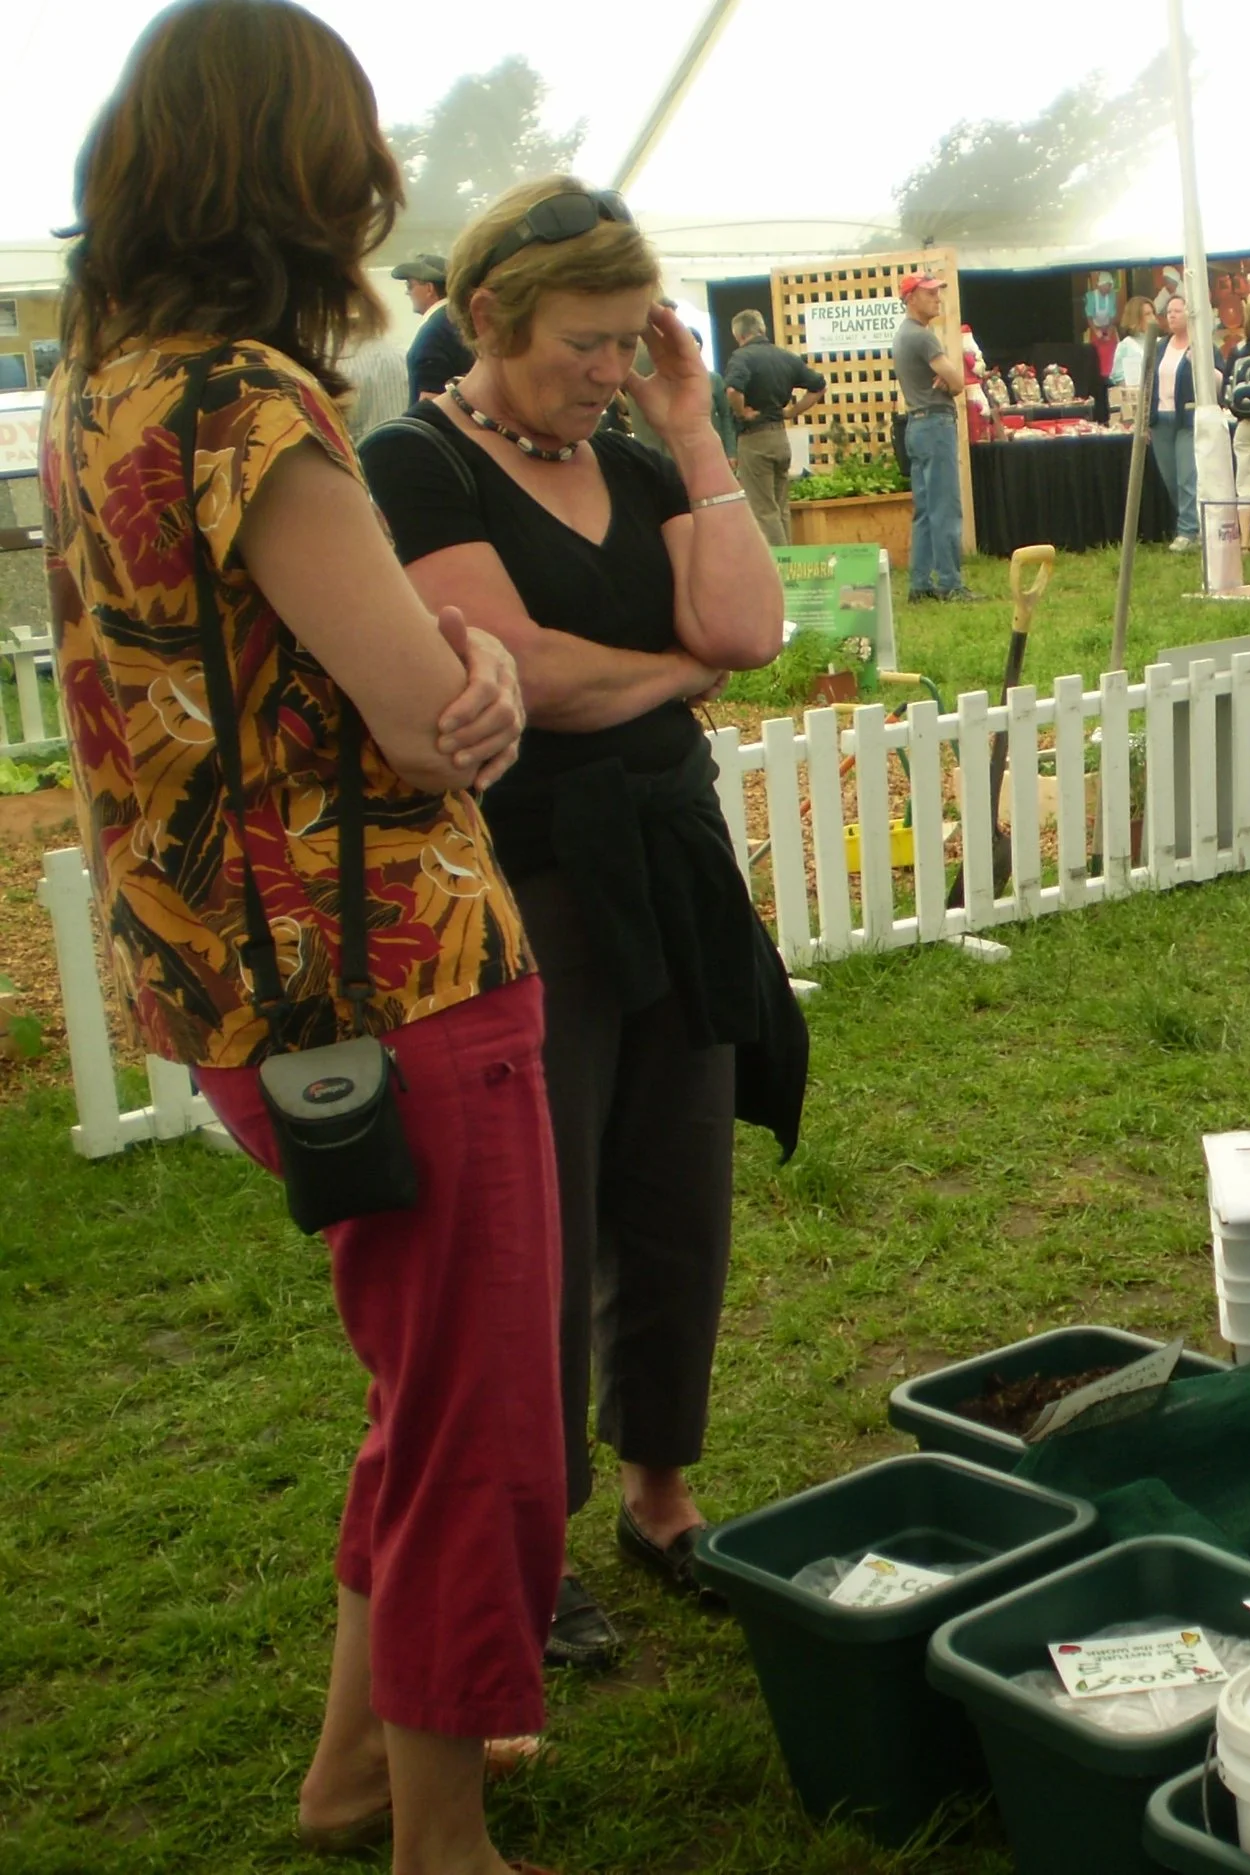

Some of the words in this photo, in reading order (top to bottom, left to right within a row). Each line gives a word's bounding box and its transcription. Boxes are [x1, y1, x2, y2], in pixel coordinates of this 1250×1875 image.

[811, 305, 851, 320] FRESH
[855, 302, 907, 317] HARVES
[831, 317, 896, 333] PLANTERS
